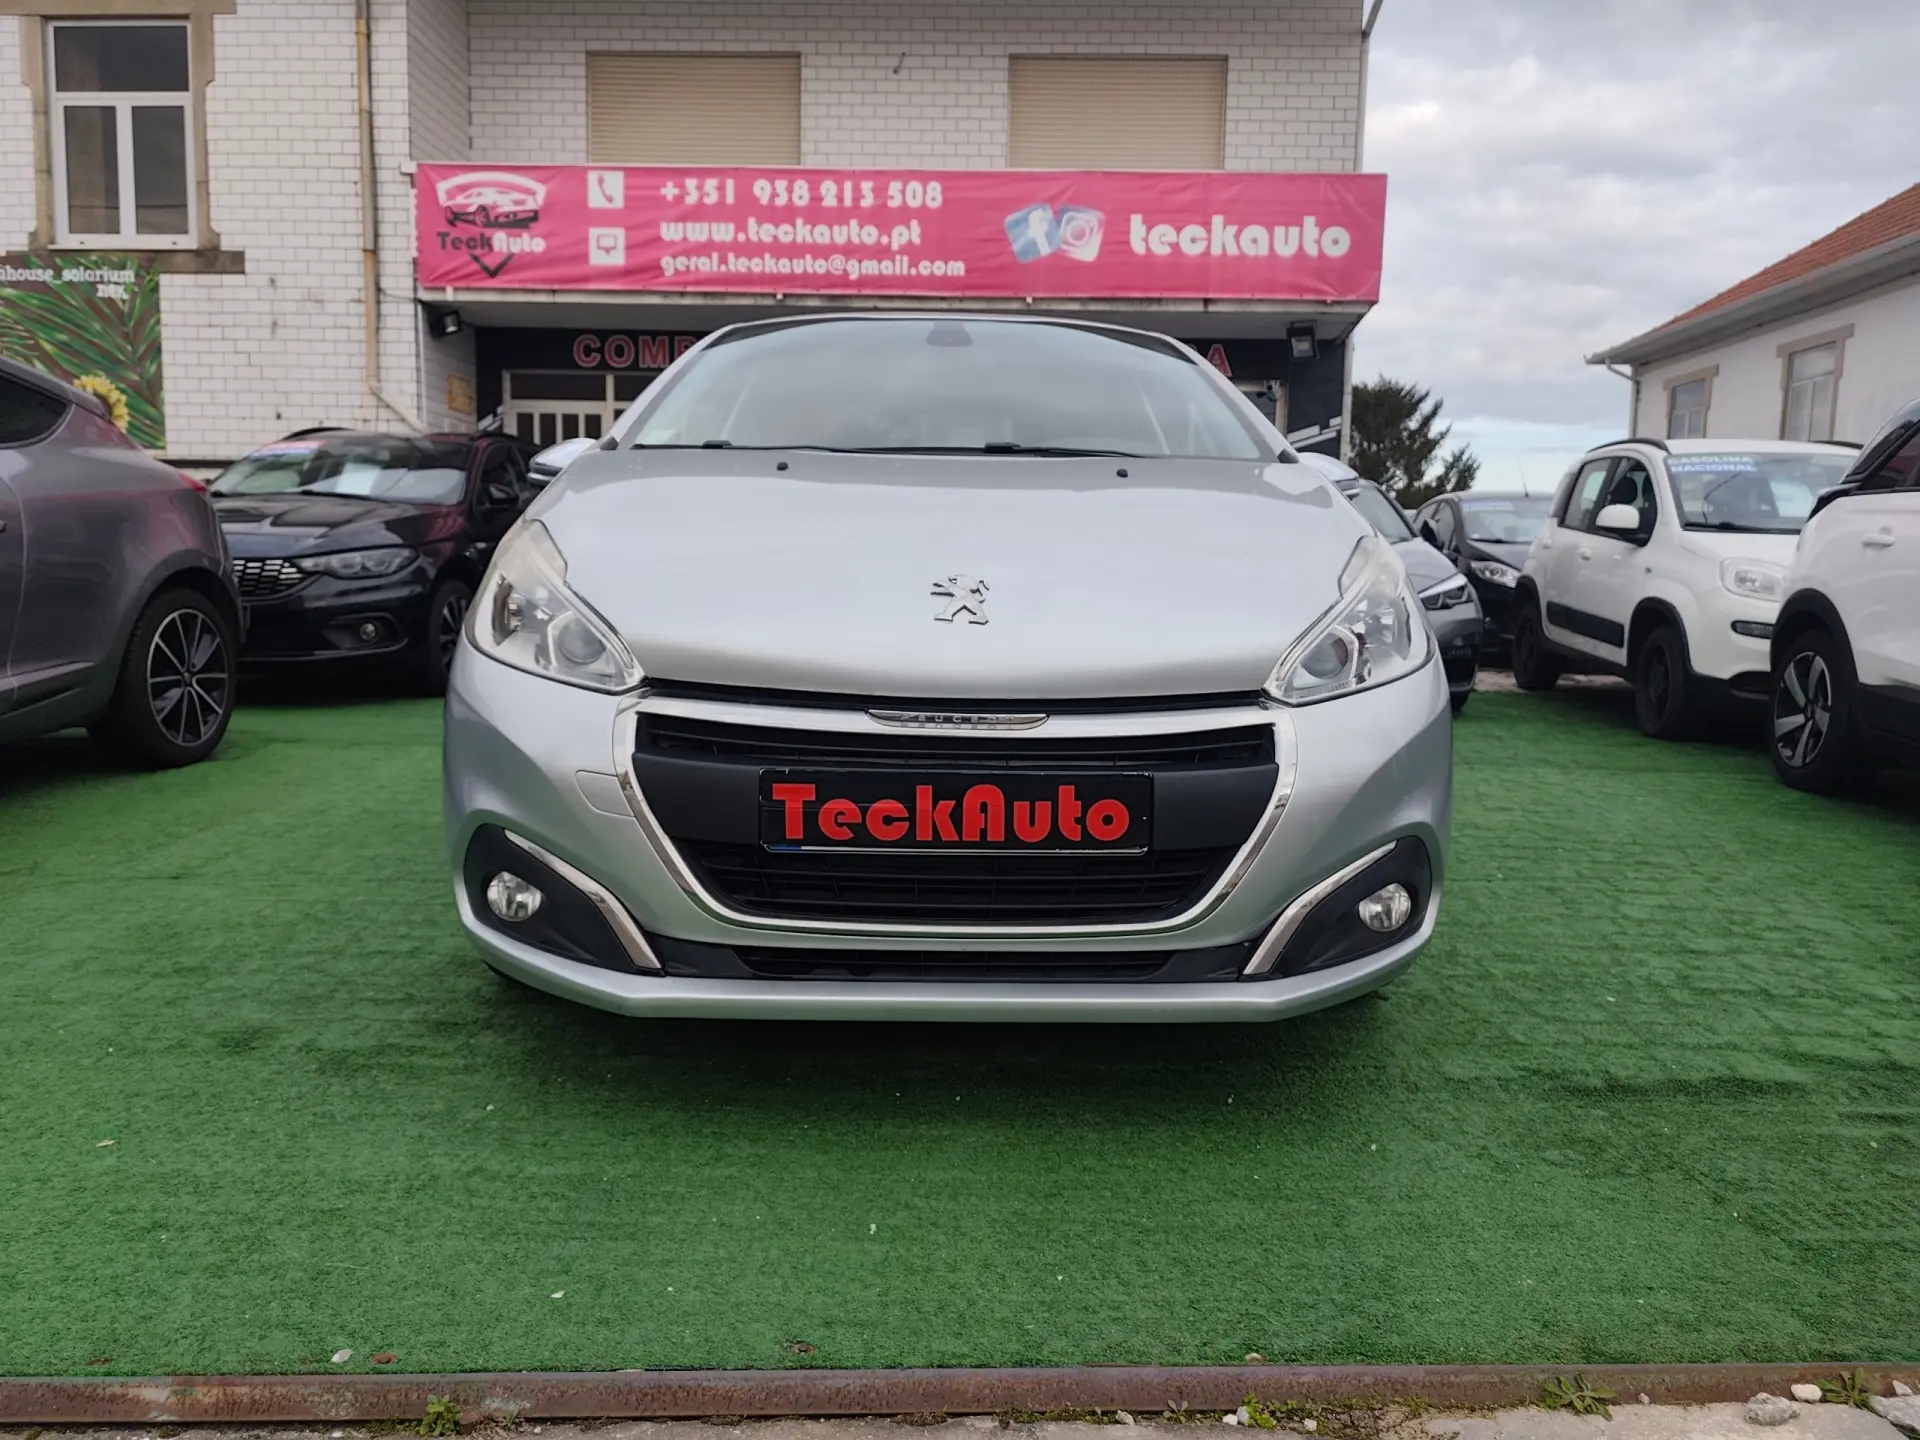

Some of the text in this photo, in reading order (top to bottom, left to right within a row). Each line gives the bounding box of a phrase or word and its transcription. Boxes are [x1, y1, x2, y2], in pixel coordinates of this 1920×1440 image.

[660, 178, 943, 208] +351 938 213 508
[437, 231, 547, 253] TeckAuto
[660, 216, 921, 250] www.teckauto.pt
[1129, 213, 1351, 258] teckauto
[660, 251, 966, 280] geral.teckauto@gmail.com
[772, 783, 1130, 843] TeckAuto
